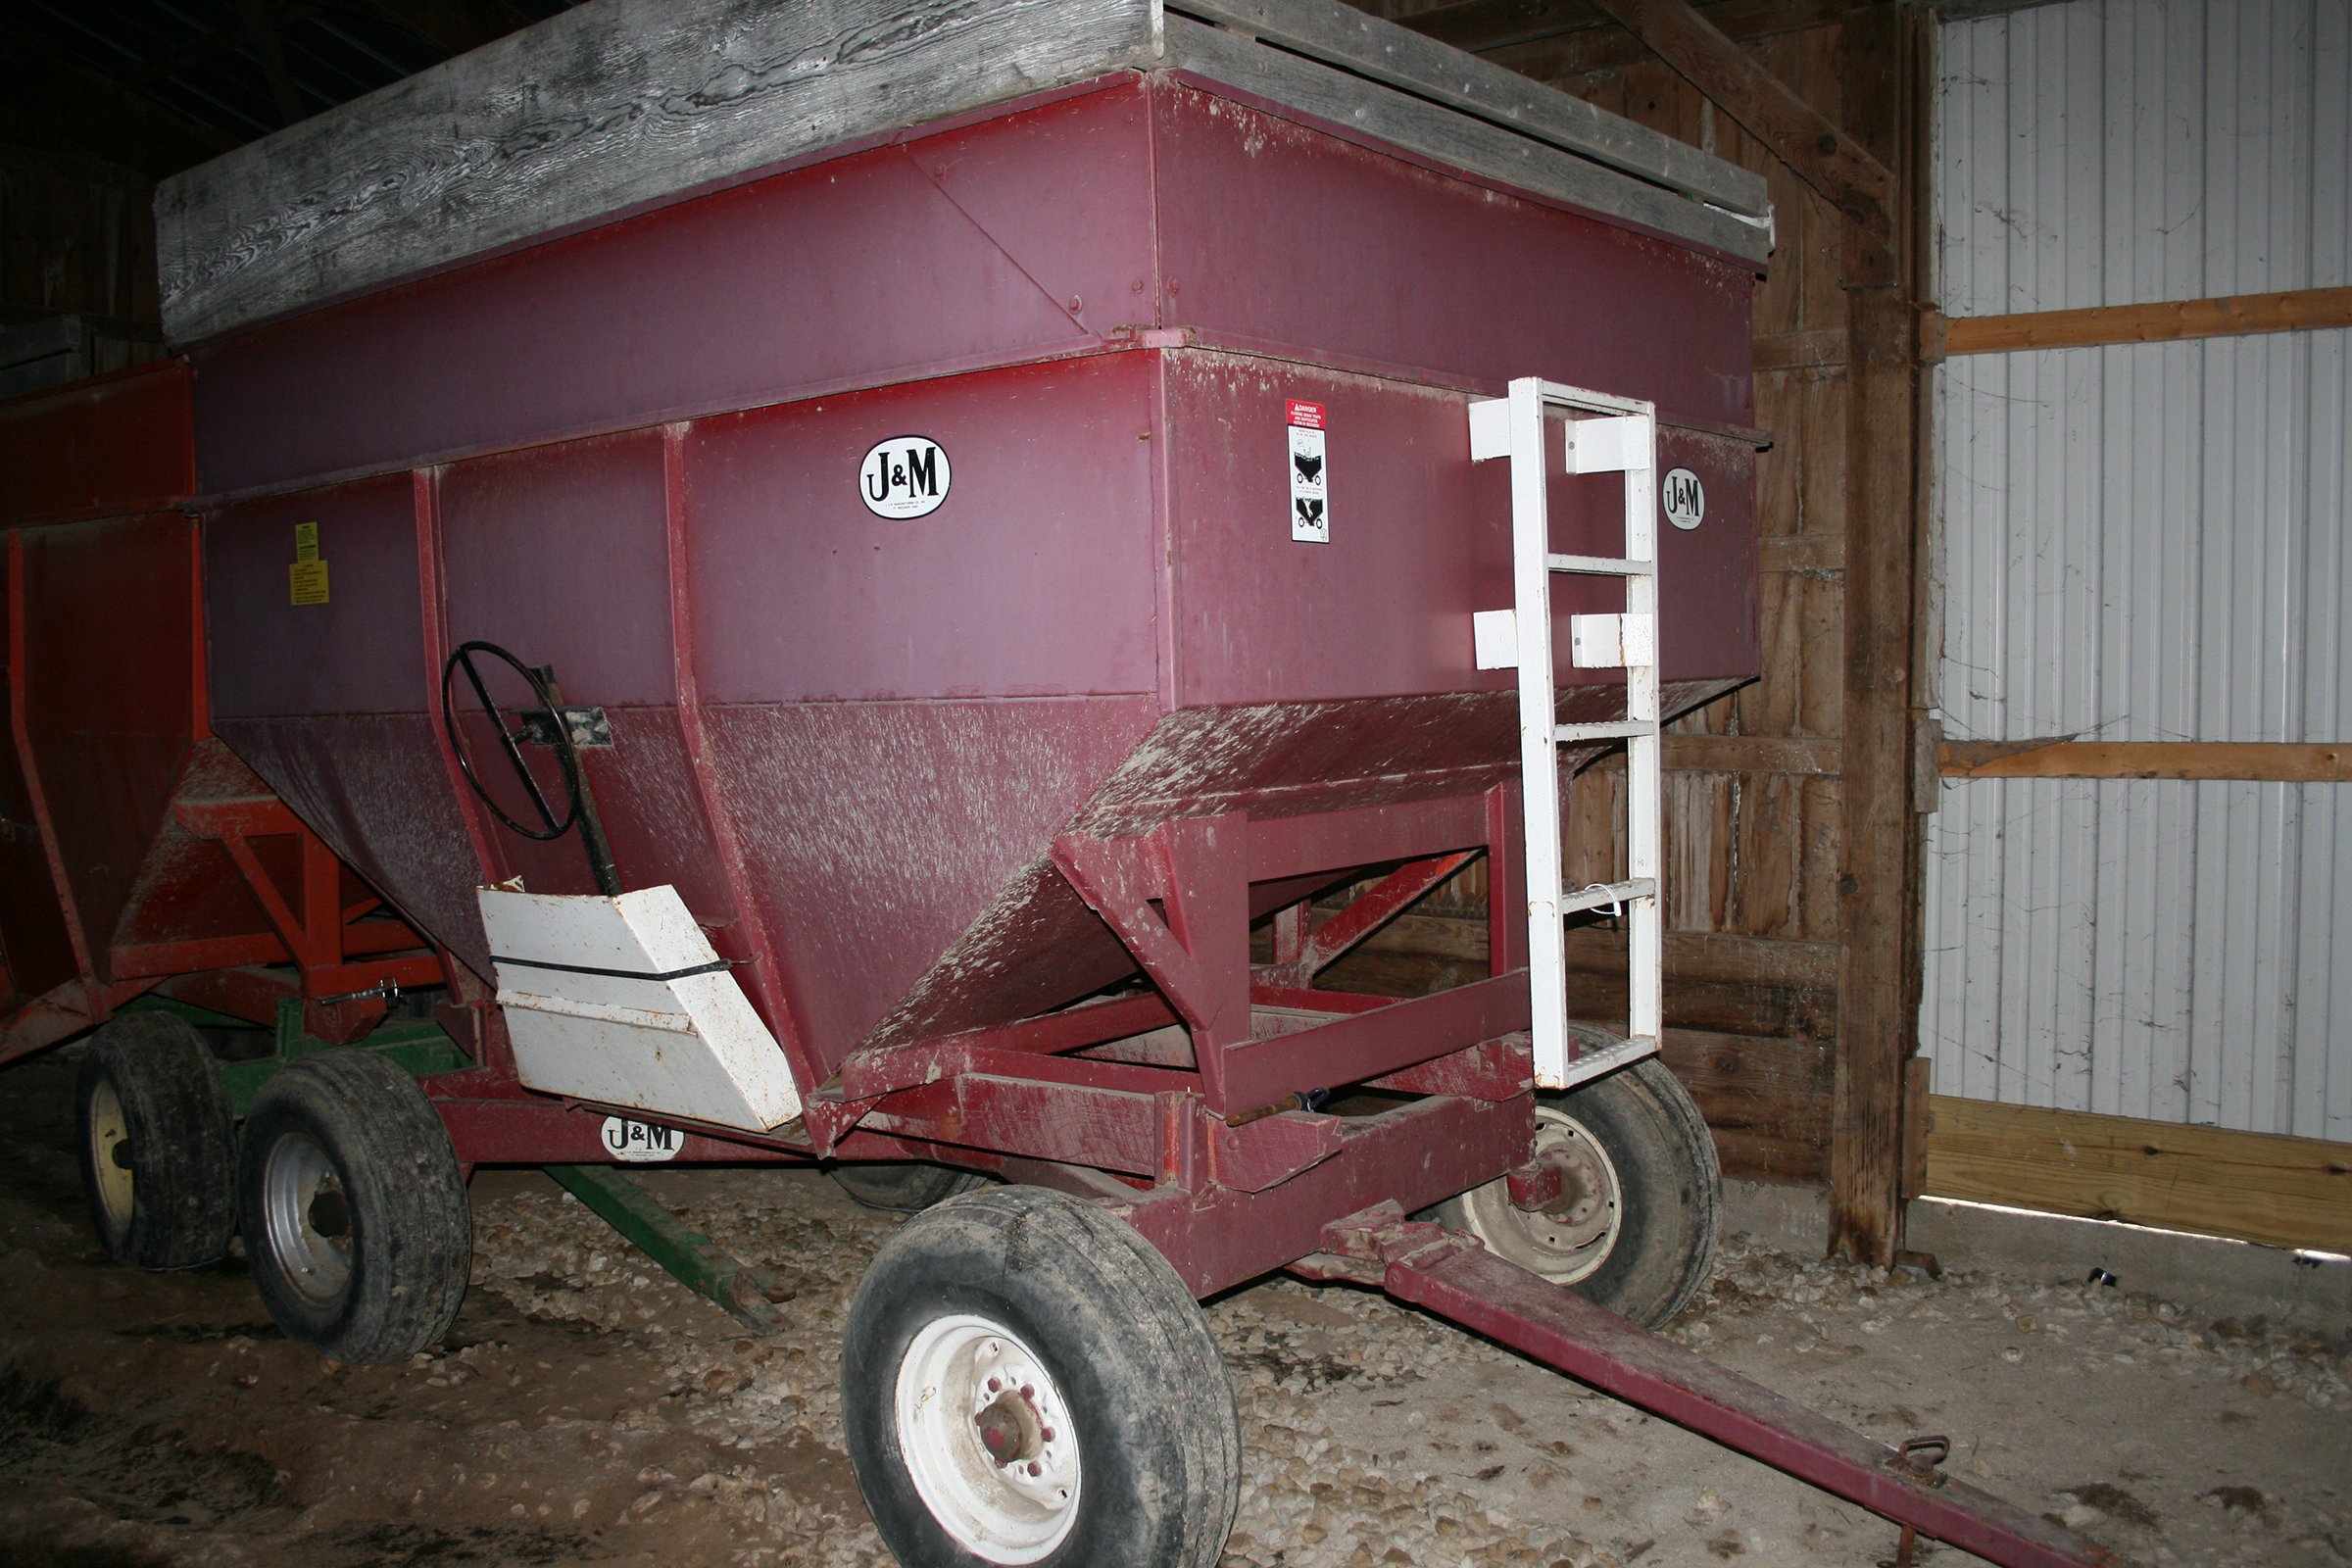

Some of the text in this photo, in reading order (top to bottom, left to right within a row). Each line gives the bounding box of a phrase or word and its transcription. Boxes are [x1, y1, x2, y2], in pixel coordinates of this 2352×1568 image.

[1298, 405, 1317, 414] DANGER
[866, 447, 940, 502] J&M
[1666, 476, 1700, 516] J&M
[608, 1118, 674, 1151] J&M
